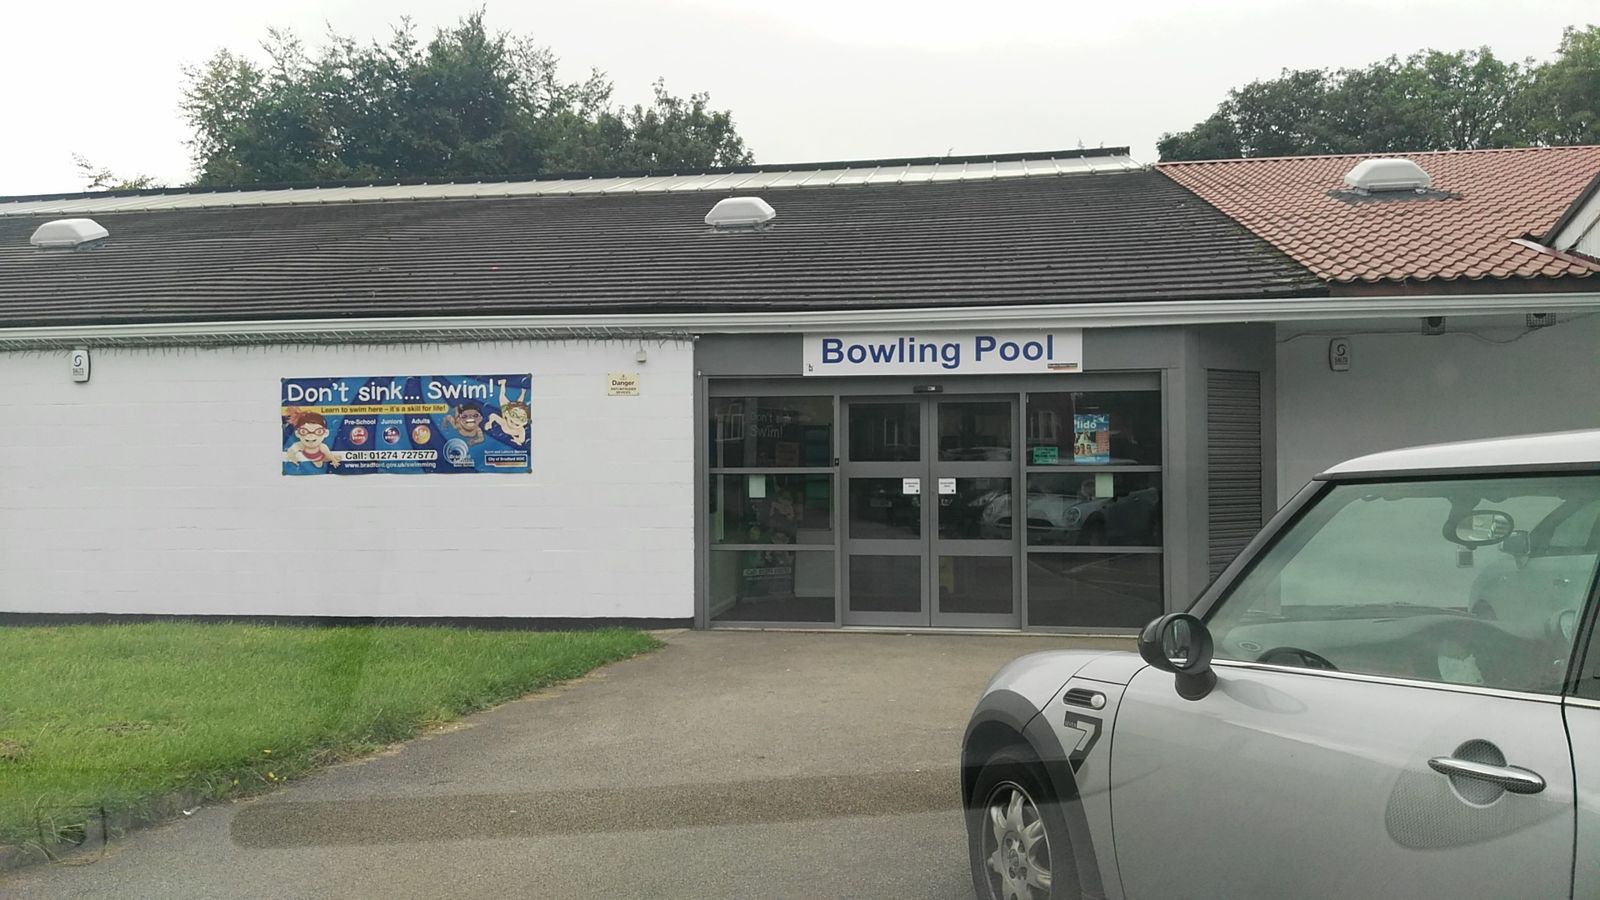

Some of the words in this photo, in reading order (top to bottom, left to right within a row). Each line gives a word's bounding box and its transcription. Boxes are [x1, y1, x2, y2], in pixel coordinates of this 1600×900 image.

[821, 338, 960, 369] Bowling
[974, 335, 1053, 362] Pool
[611, 379, 635, 387] Danger
[287, 382, 349, 402] Don't
[358, 381, 420, 401] sink...
[427, 378, 494, 399] Swim!
[345, 452, 367, 460] Call:
[369, 451, 398, 460] 01274
[401, 451, 436, 459] 727577
[344, 461, 437, 469] www.bradford.gov.uk/swimming
